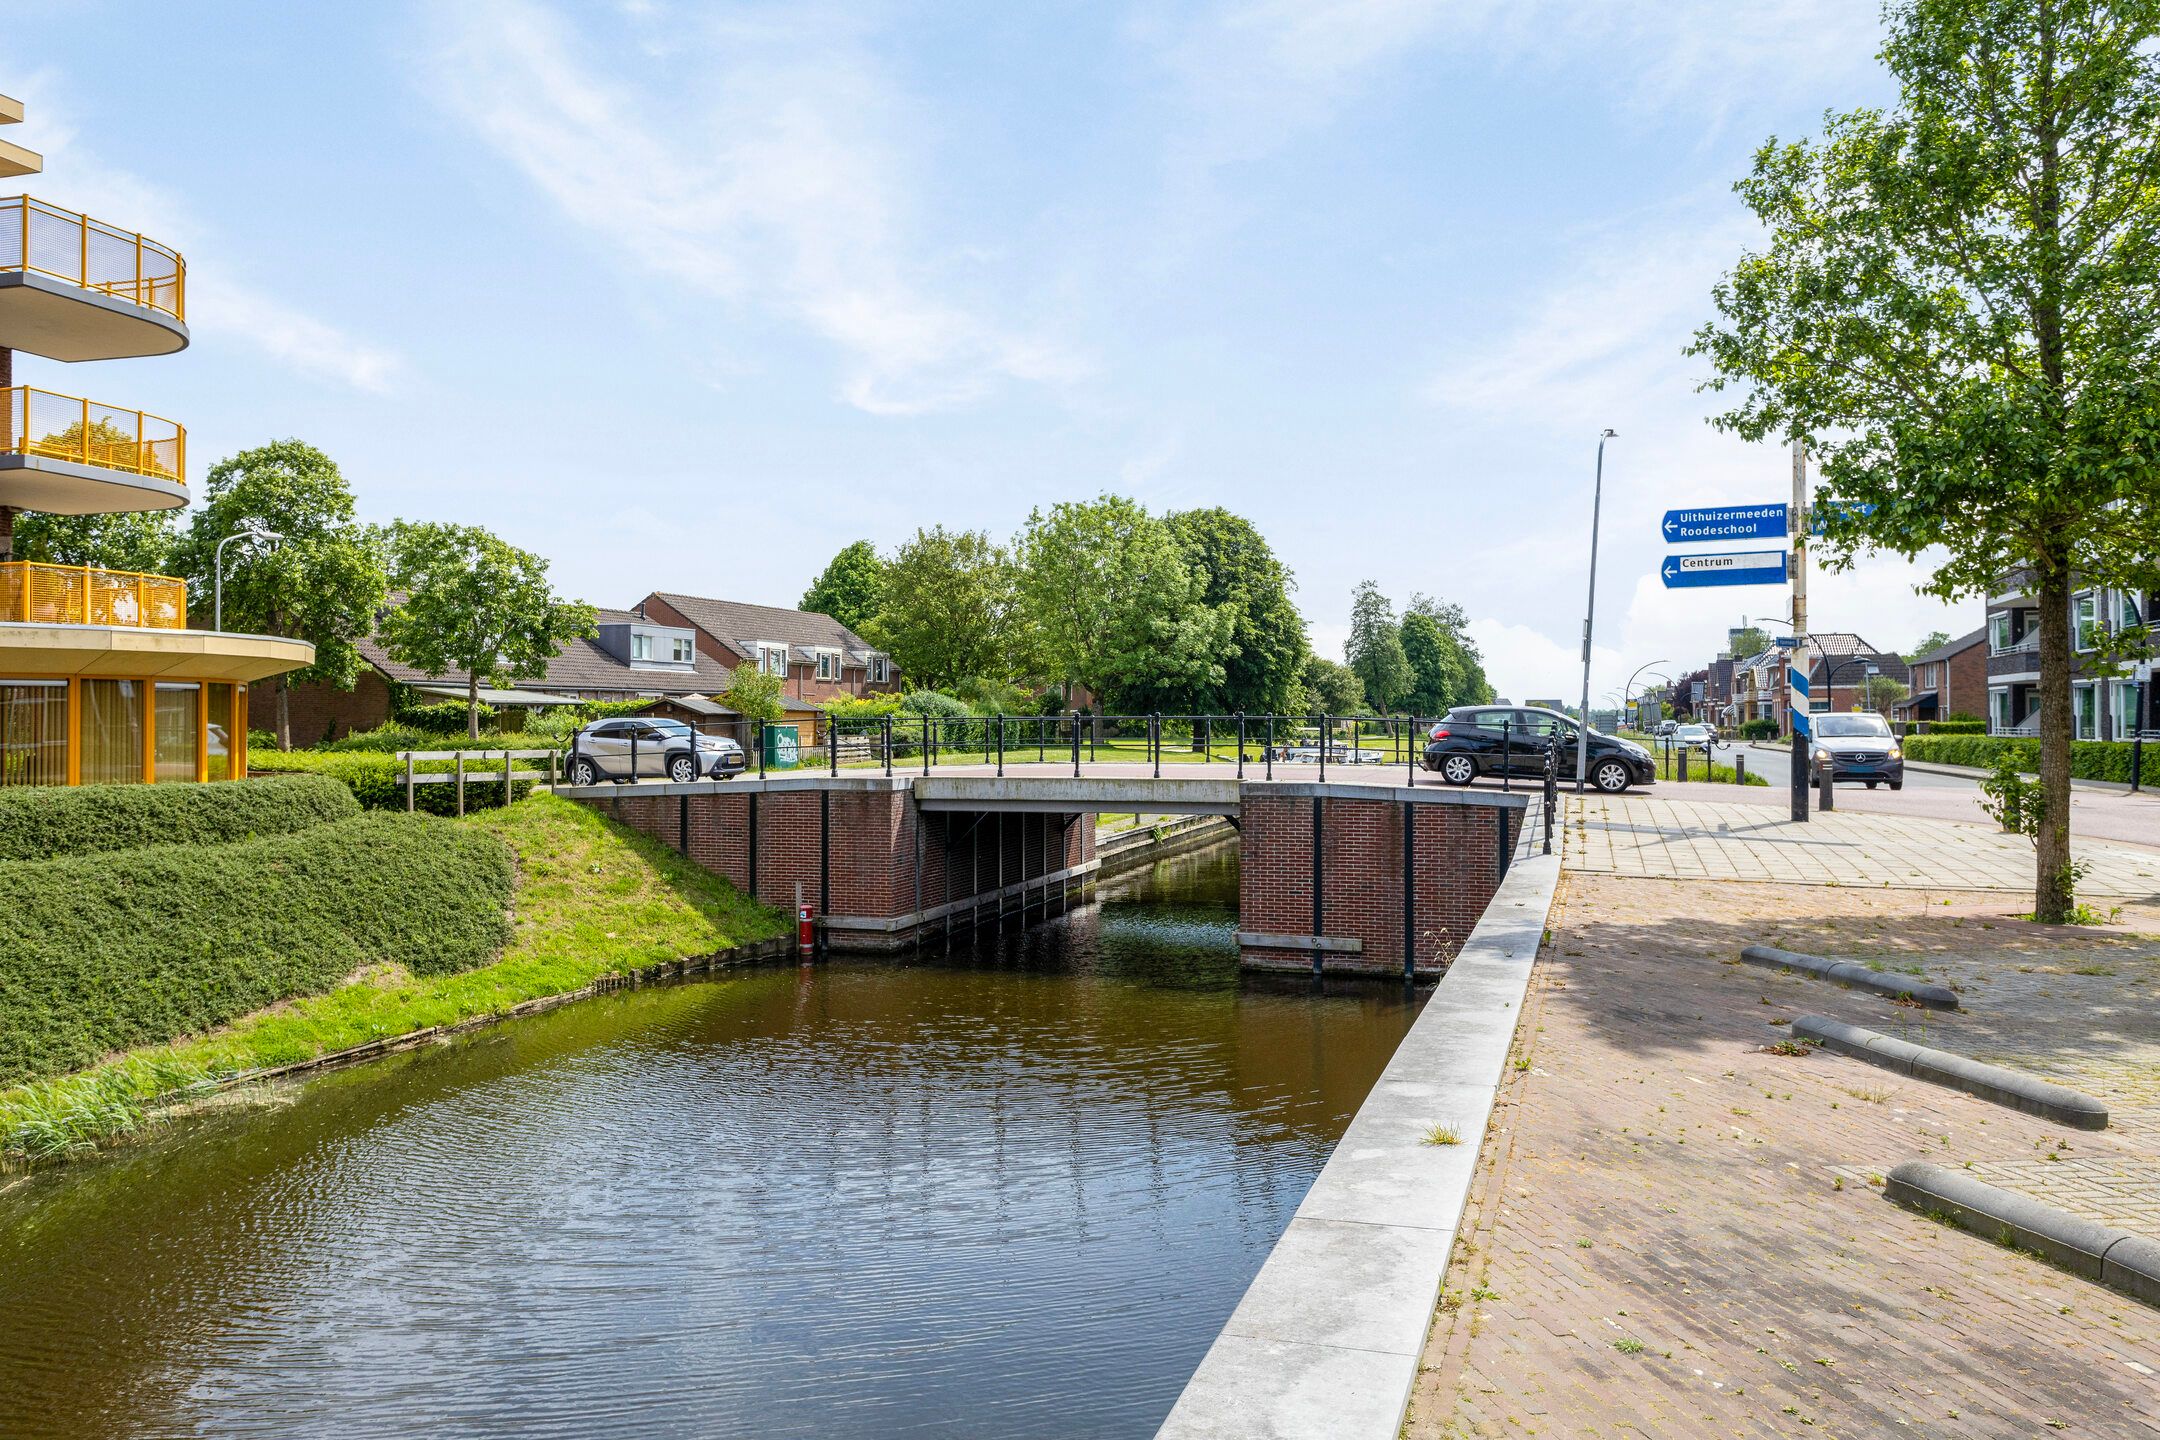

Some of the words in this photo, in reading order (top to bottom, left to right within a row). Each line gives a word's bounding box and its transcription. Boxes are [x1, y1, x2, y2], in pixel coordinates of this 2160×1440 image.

[1680, 508, 1784, 523] Uithuizermeeden
[1680, 523, 1757, 537] Roodeschool
[1682, 558, 1733, 568] Centrum
